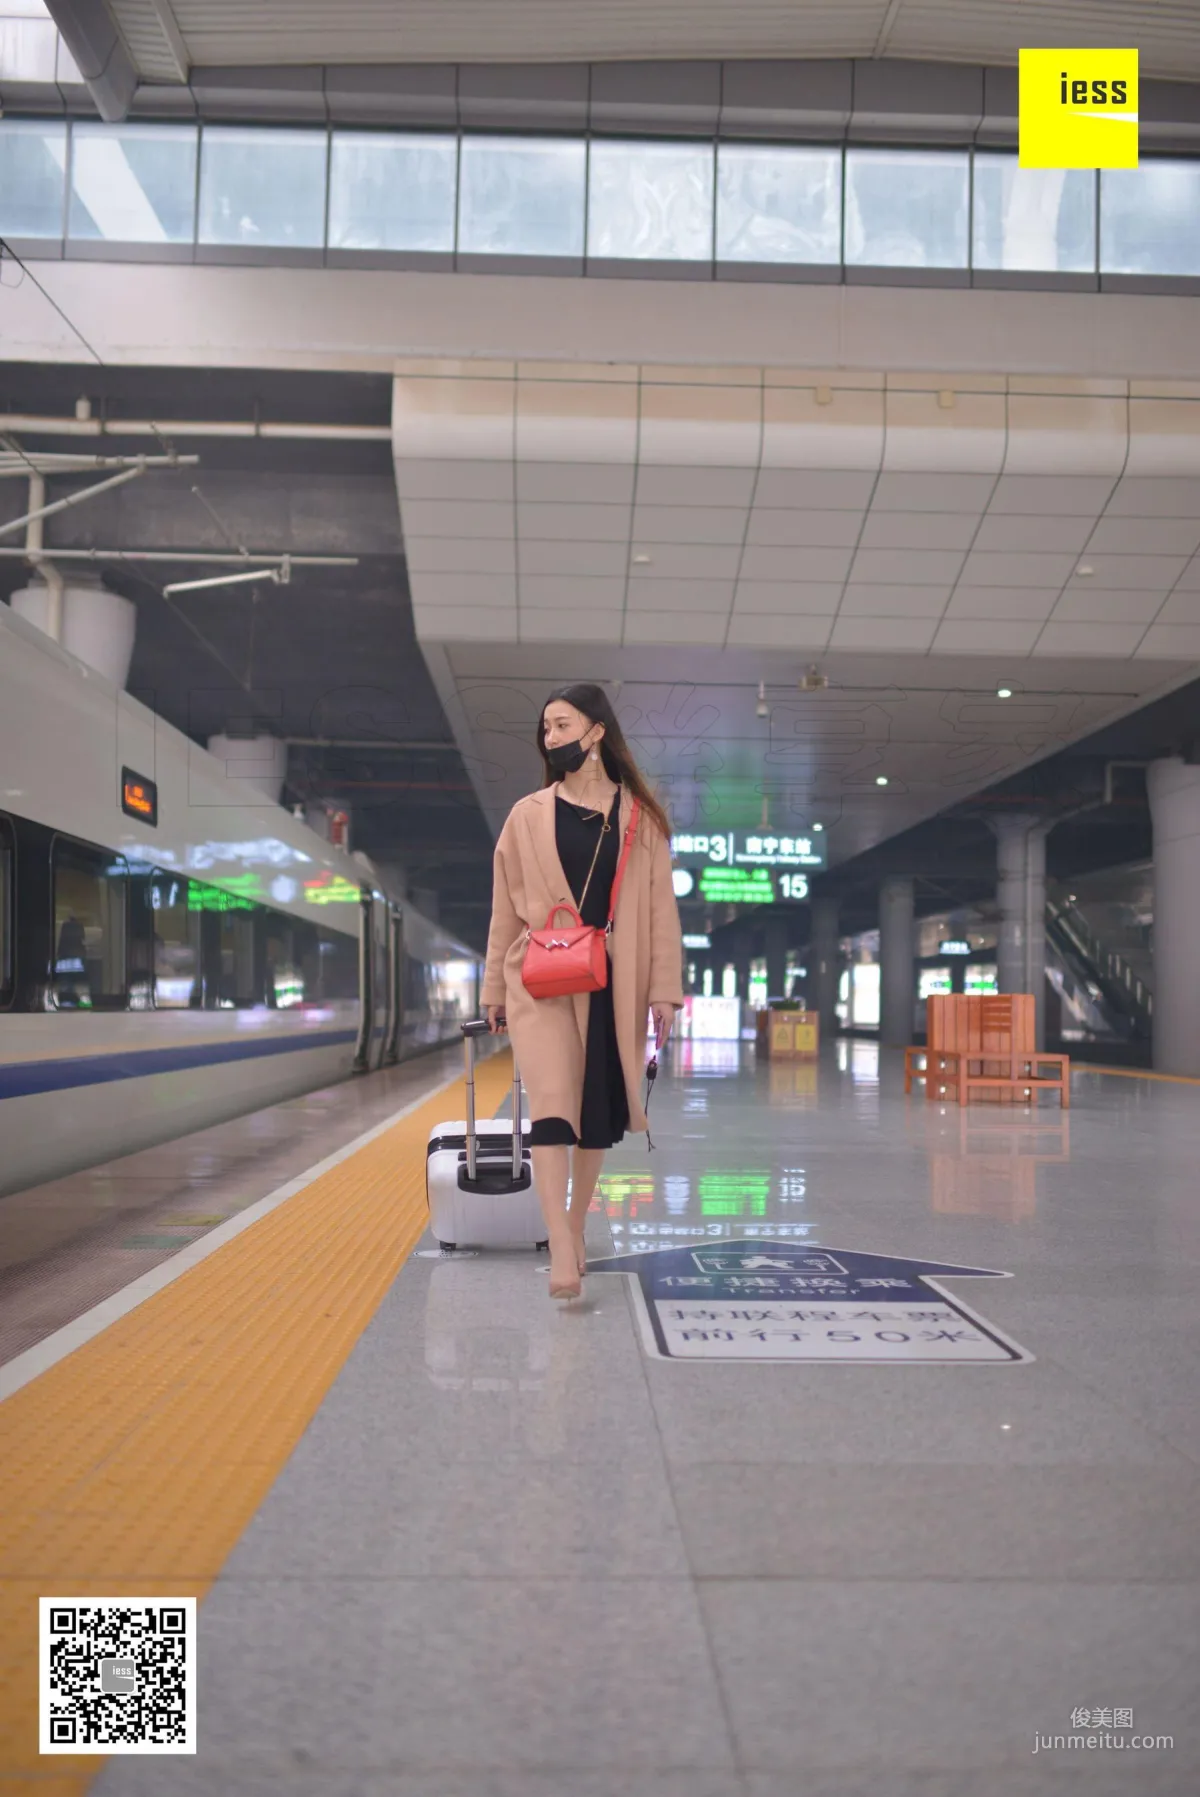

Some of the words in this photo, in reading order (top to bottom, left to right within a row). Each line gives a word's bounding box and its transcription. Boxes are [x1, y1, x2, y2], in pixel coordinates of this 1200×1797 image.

[779, 874, 808, 898] 15
[658, 1275, 912, 1288] 便捷换乘
[721, 1287, 860, 1295] Transfer
[669, 1309, 961, 1321] 持联程车票
[677, 1328, 982, 1342] 前行50米
